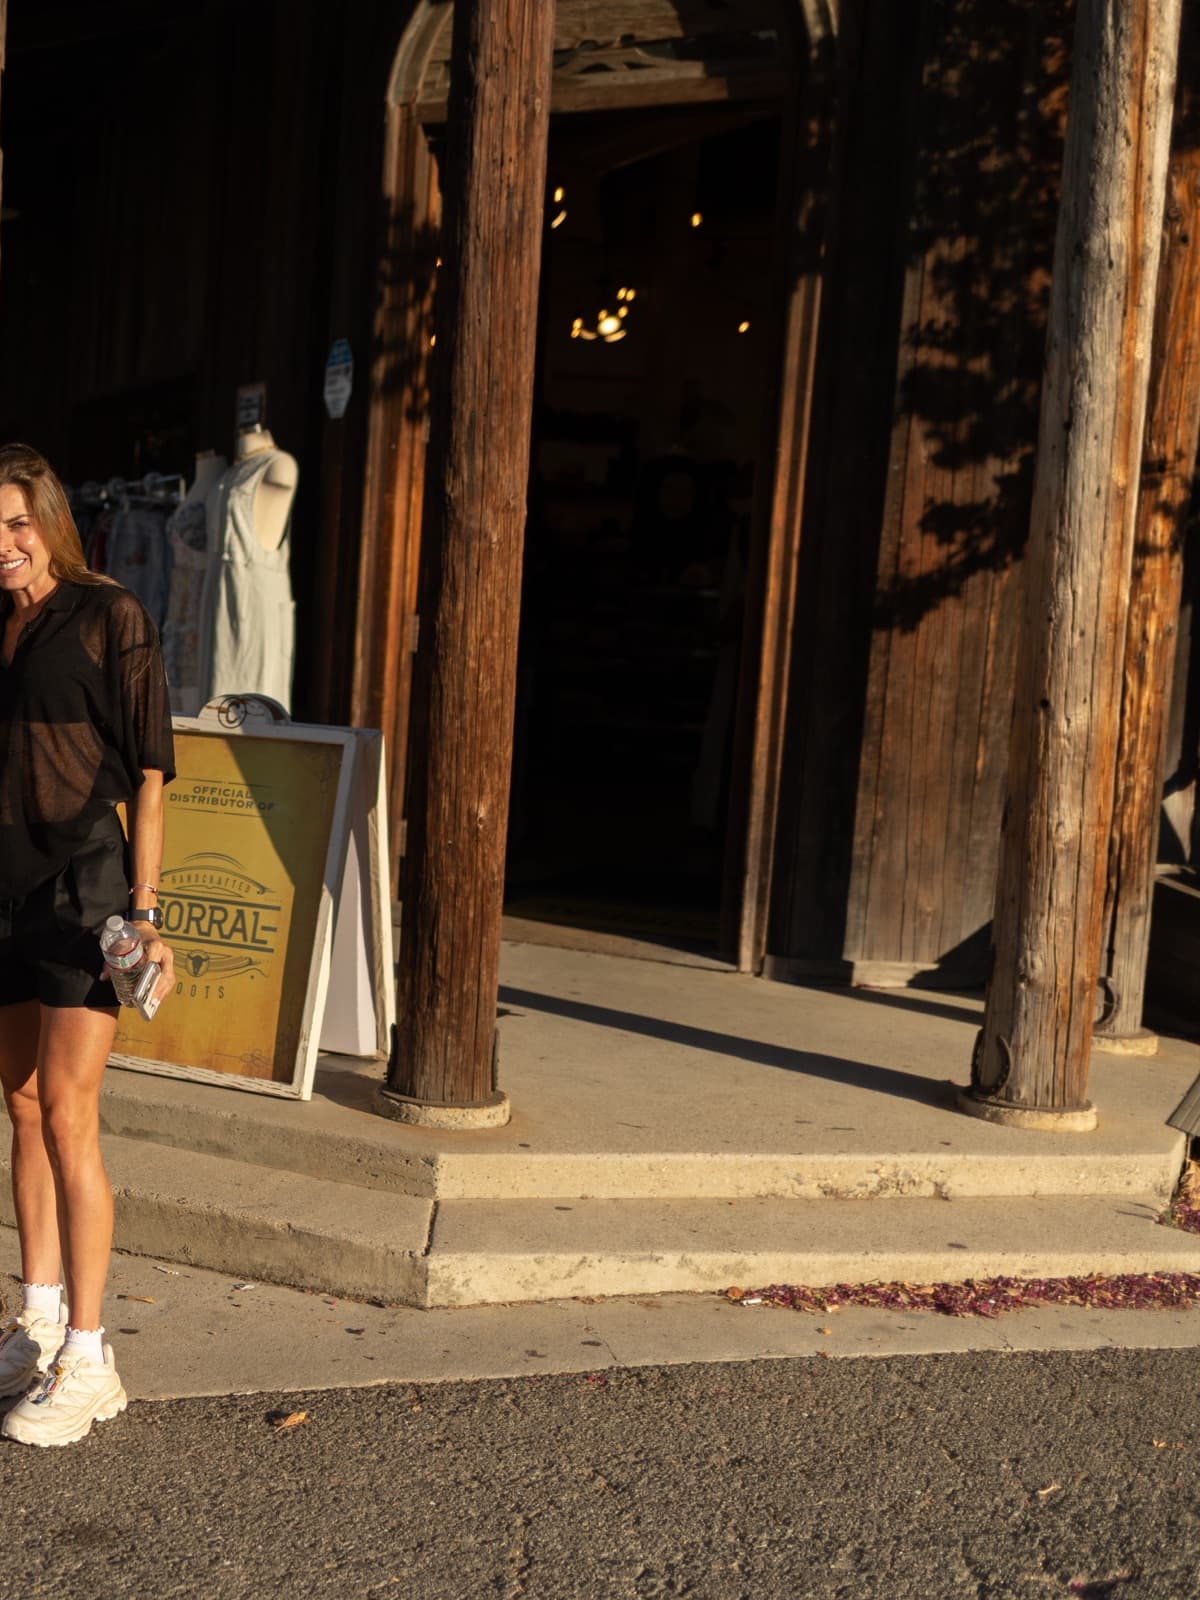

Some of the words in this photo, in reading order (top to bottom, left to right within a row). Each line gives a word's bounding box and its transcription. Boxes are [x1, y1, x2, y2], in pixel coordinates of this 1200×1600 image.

[169, 792, 254, 809] DISTRIBUTOR
[258, 801, 276, 811] OF
[192, 785, 253, 800] OFFICIAL
[159, 899, 268, 945] ORRAL
[176, 982, 225, 999] OOTS
